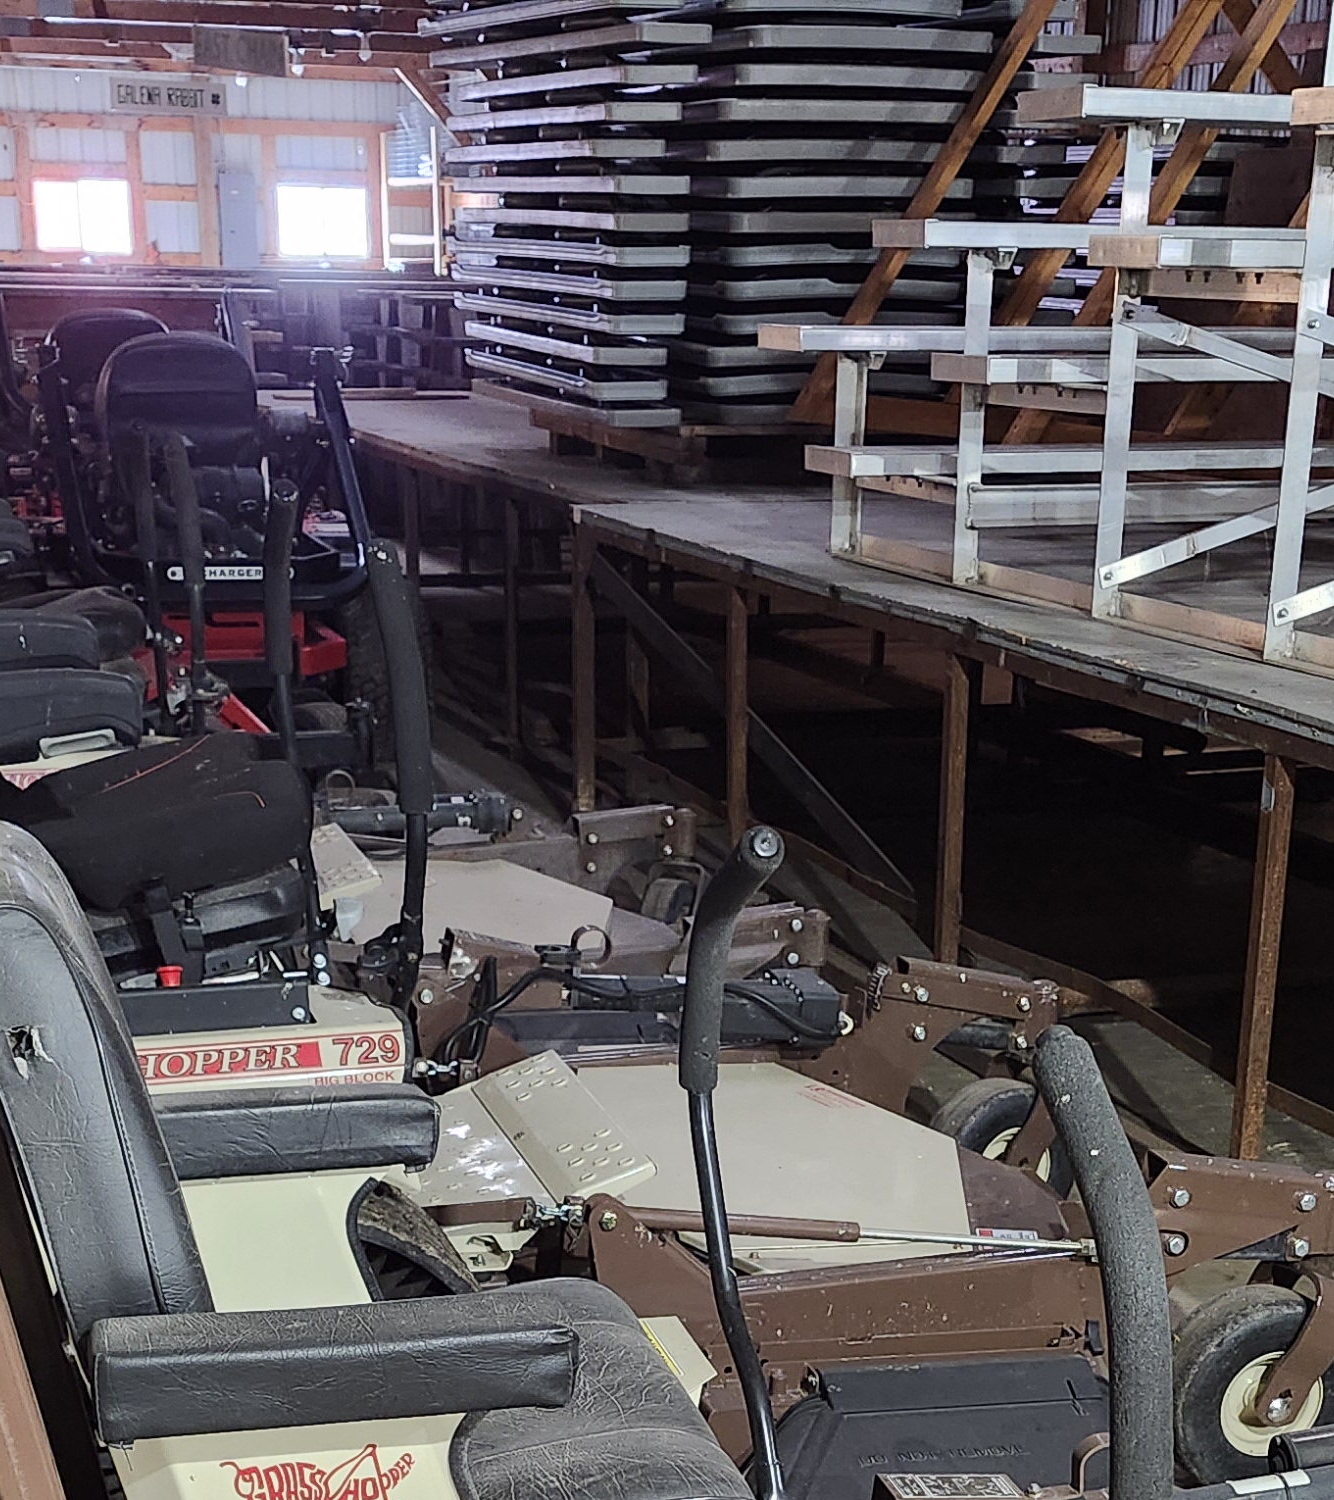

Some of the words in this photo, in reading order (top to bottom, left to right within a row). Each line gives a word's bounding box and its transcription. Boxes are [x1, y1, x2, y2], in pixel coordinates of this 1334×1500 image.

[117, 84, 161, 106] GALENA
[204, 568, 263, 580] HARGER
[332, 1033, 401, 1066] 729
[314, 1074, 340, 1086] BIG
[345, 1071, 396, 1083] BLOCK
